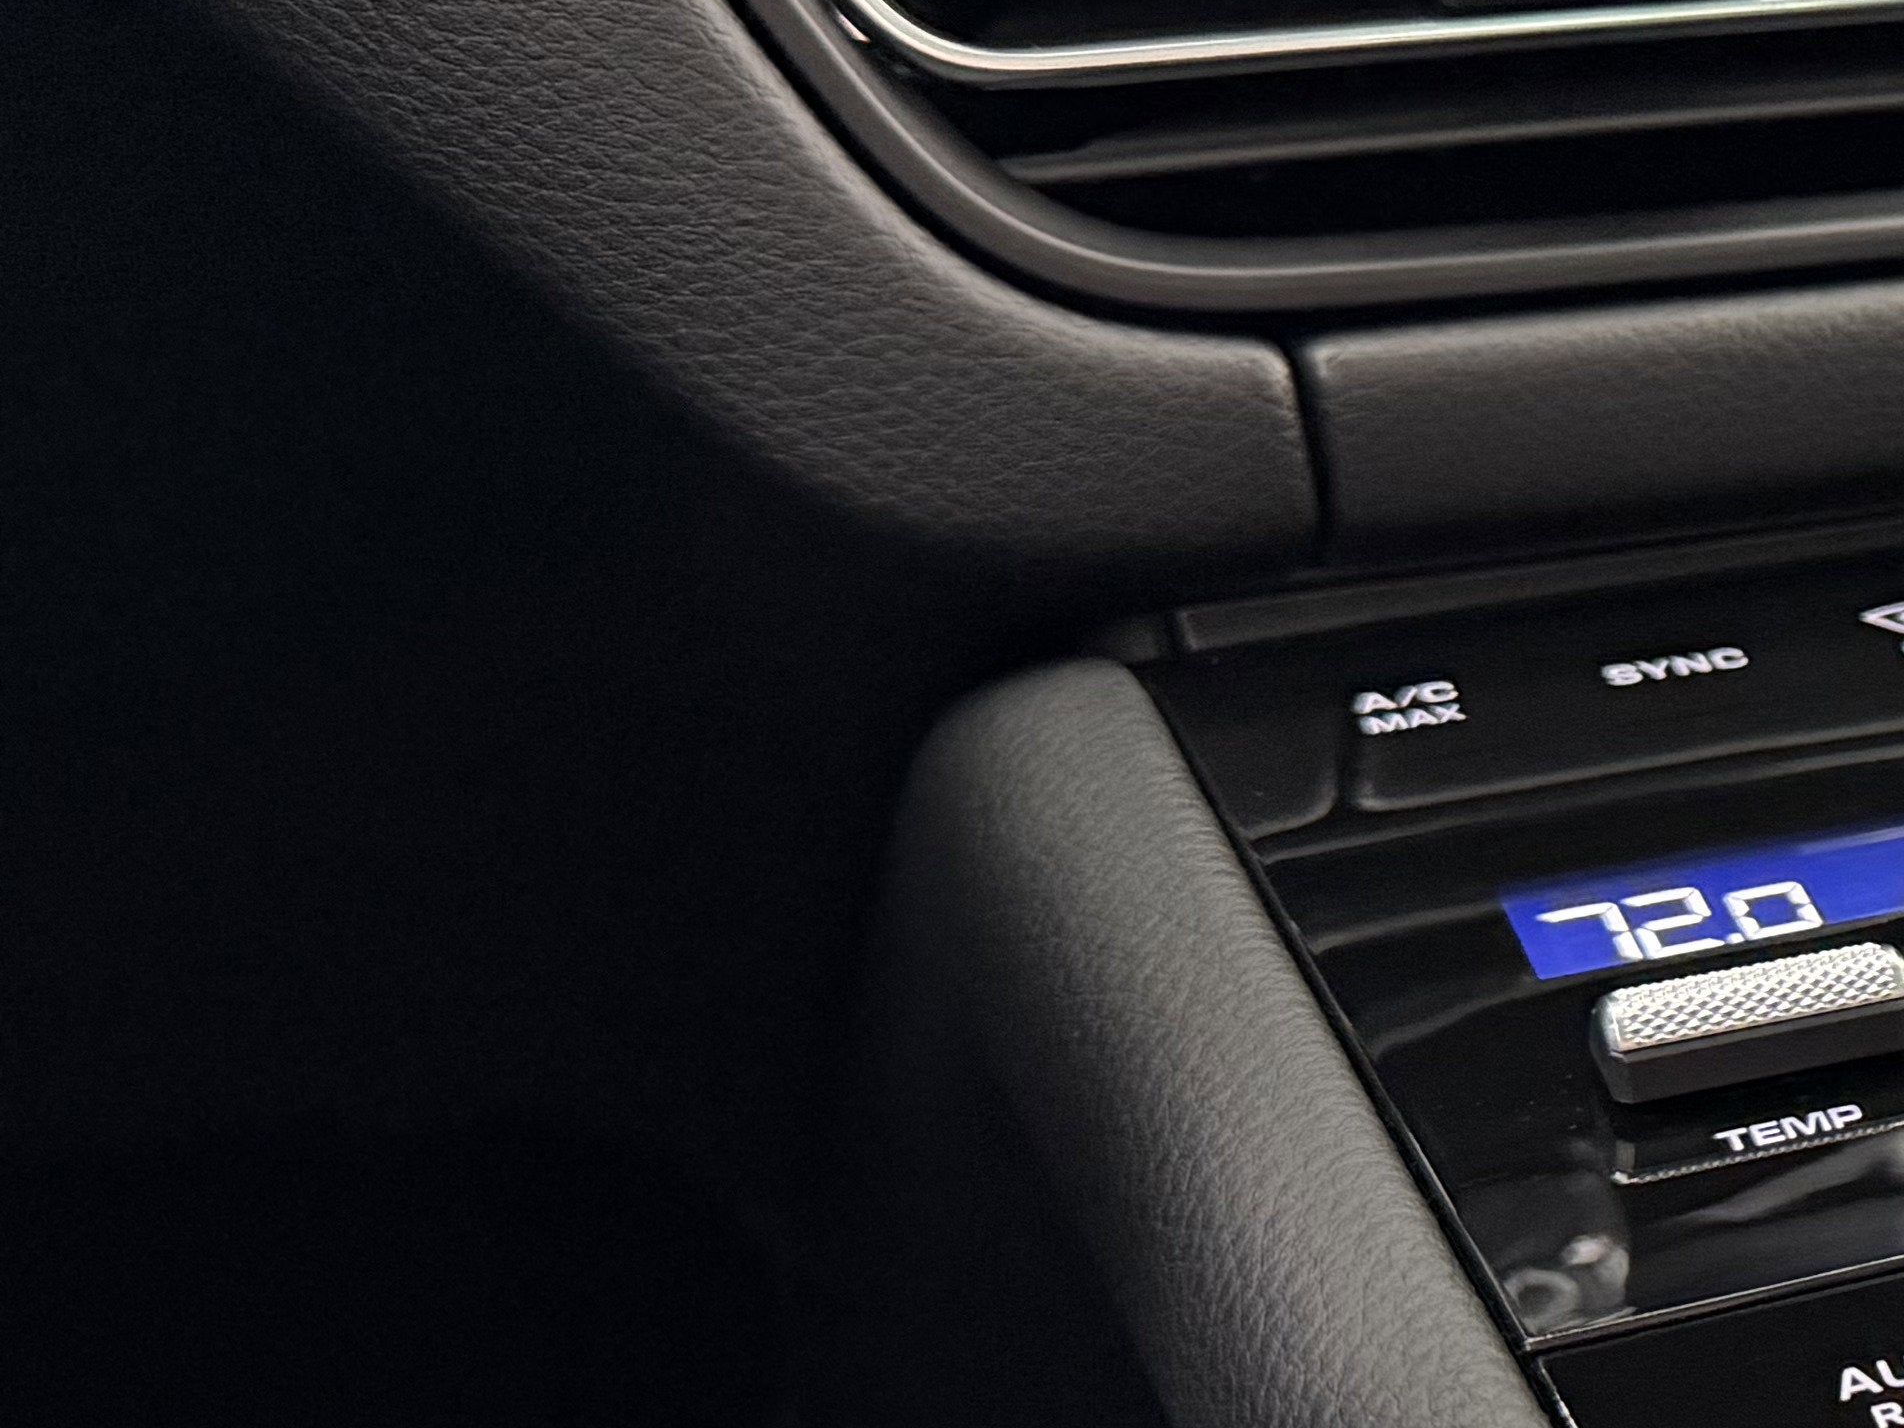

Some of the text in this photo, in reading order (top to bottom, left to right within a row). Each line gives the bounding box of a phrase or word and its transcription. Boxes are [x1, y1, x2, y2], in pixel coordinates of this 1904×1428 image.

[1600, 647, 1750, 687] SYNC
[1351, 680, 1460, 715] A/C
[1358, 703, 1468, 735] MAX
[1535, 881, 1824, 962] 72.0
[1712, 1104, 1863, 1151] TEMP
